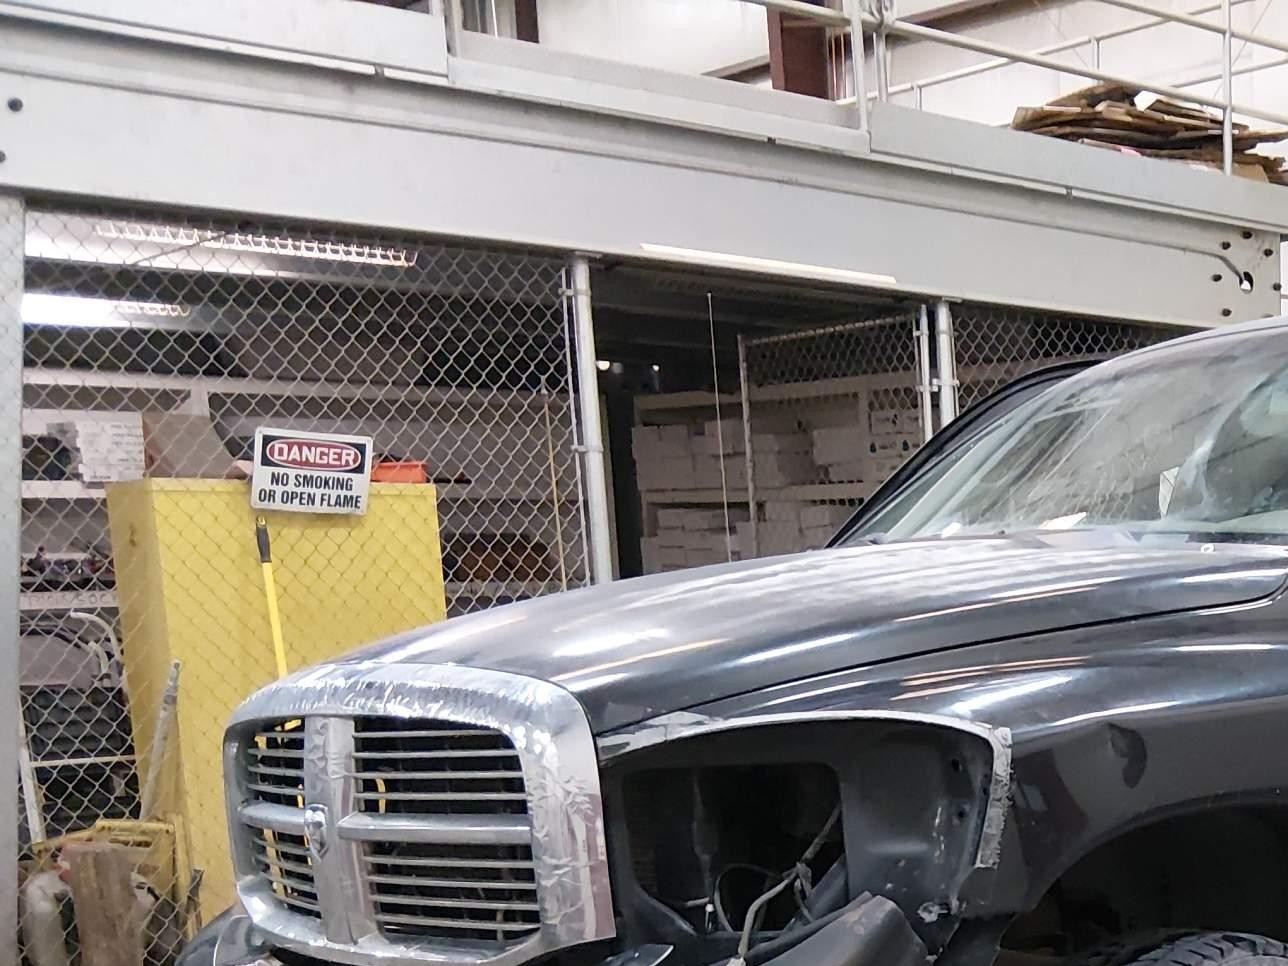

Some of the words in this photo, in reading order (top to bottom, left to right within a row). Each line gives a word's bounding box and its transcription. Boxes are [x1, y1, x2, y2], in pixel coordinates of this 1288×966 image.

[273, 443, 355, 466] DANGER
[270, 471, 290, 487] NO
[293, 473, 354, 491] SMOKING
[258, 488, 277, 504] OR
[280, 489, 317, 507] OPEN
[319, 492, 362, 509] FLAME
